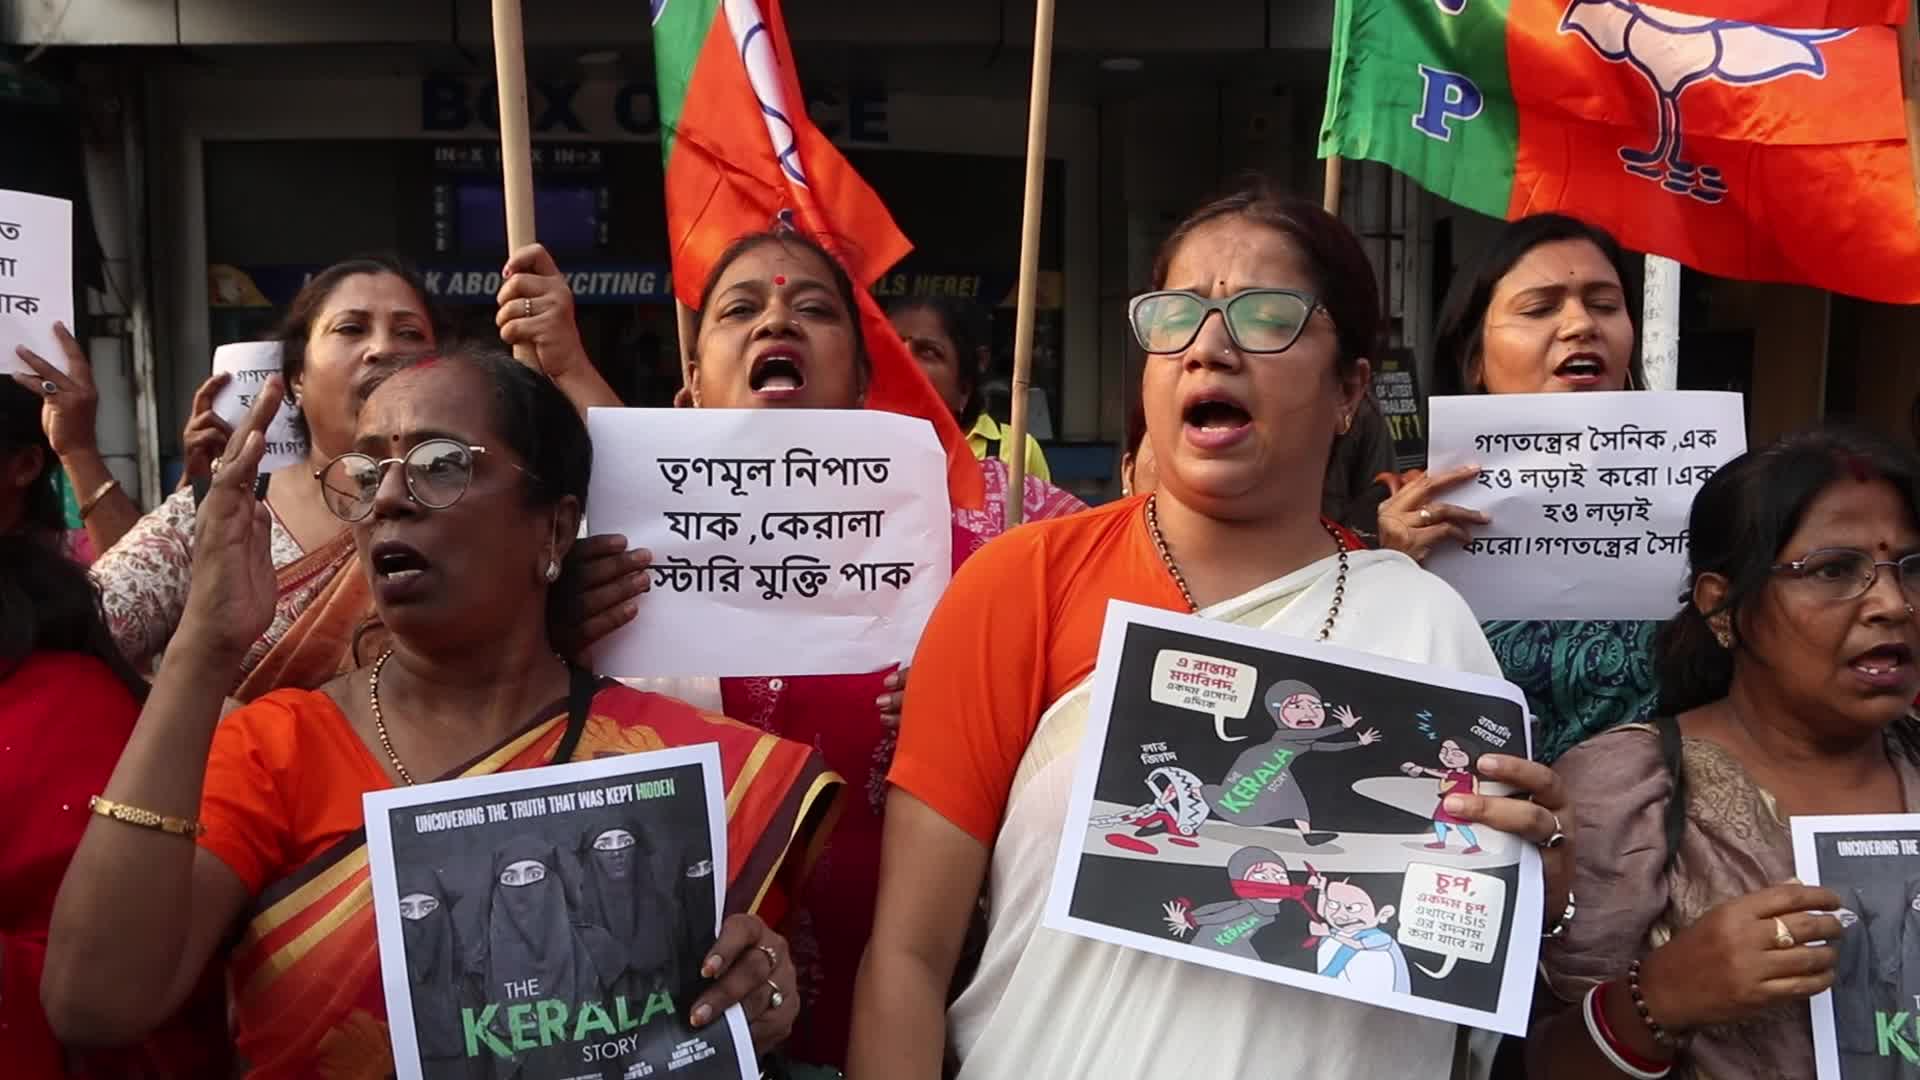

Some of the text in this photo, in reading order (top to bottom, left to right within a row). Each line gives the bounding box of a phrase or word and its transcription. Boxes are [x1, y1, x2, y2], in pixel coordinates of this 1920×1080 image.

[1412, 63, 1484, 142] P
[443, 272, 501, 295] ABO
[561, 272, 656, 295] XCITING
[1475, 432, 1582, 455] গণতন্ত্রের
[1587, 424, 1668, 452] সৈনিক
[657, 448, 891, 496] তৃণমূল নিপাত
[1478, 468, 1512, 489] হও
[1519, 463, 1587, 493] লড়াই
[1597, 466, 1659, 488] করো
[1542, 496, 1653, 526] হও লড়াই
[664, 512, 742, 541] যাক
[648, 555, 915, 600] স্টারি মুক্তি পাক
[1175, 658, 1190, 671] এ
[1218, 747, 1294, 814] KERALA
[415, 778, 675, 833] UNCOVERING THE TRUTH THAT WAS KEPT HIDDEN
[1837, 839, 1920, 857] UNCOVERING THE
[1459, 914, 1486, 930] ISIS
[504, 978, 541, 1000] THE
[461, 991, 676, 1061] KERALA
[582, 1033, 640, 1063] STORY
